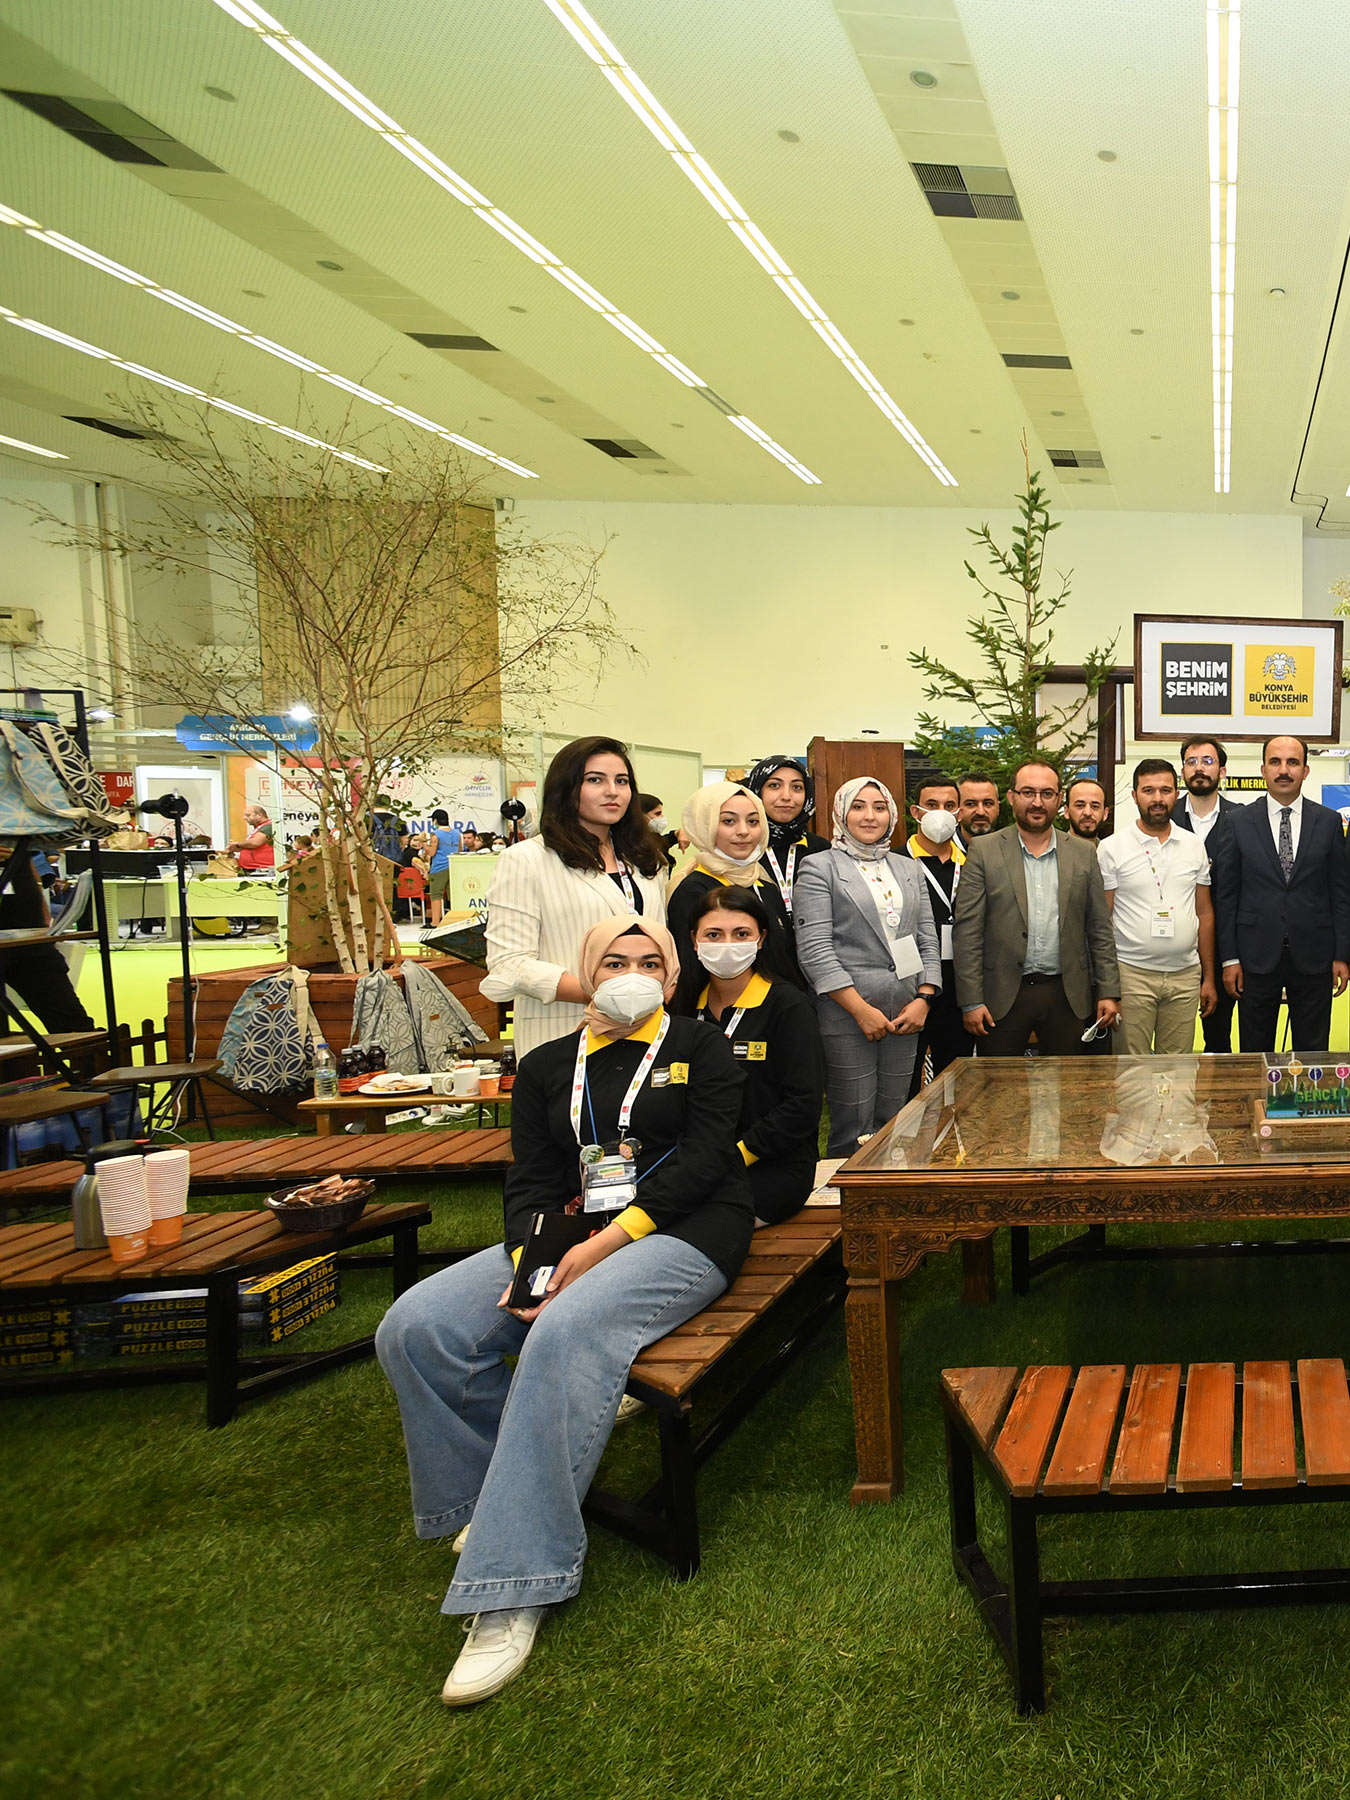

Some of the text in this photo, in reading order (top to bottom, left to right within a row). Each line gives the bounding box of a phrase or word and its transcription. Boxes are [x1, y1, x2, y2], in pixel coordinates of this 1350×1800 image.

[1264, 684, 1294, 692] KONYA
[1249, 692, 1309, 704] BÜYÜKŞEHİR
[1260, 703, 1297, 711] BELEDİYESİ
[1241, 779, 1268, 788] MERKE
[283, 810, 320, 823] eneya
[302, 1263, 334, 1287] PUZZLE
[303, 1282, 335, 1306] PUZZLE
[121, 1299, 206, 1313] PUZZLE 1000
[304, 1299, 336, 1324] PUZZLE
[123, 1319, 207, 1333] PUZZLE 1000
[121, 1339, 206, 1354] PUZZLE 1000
